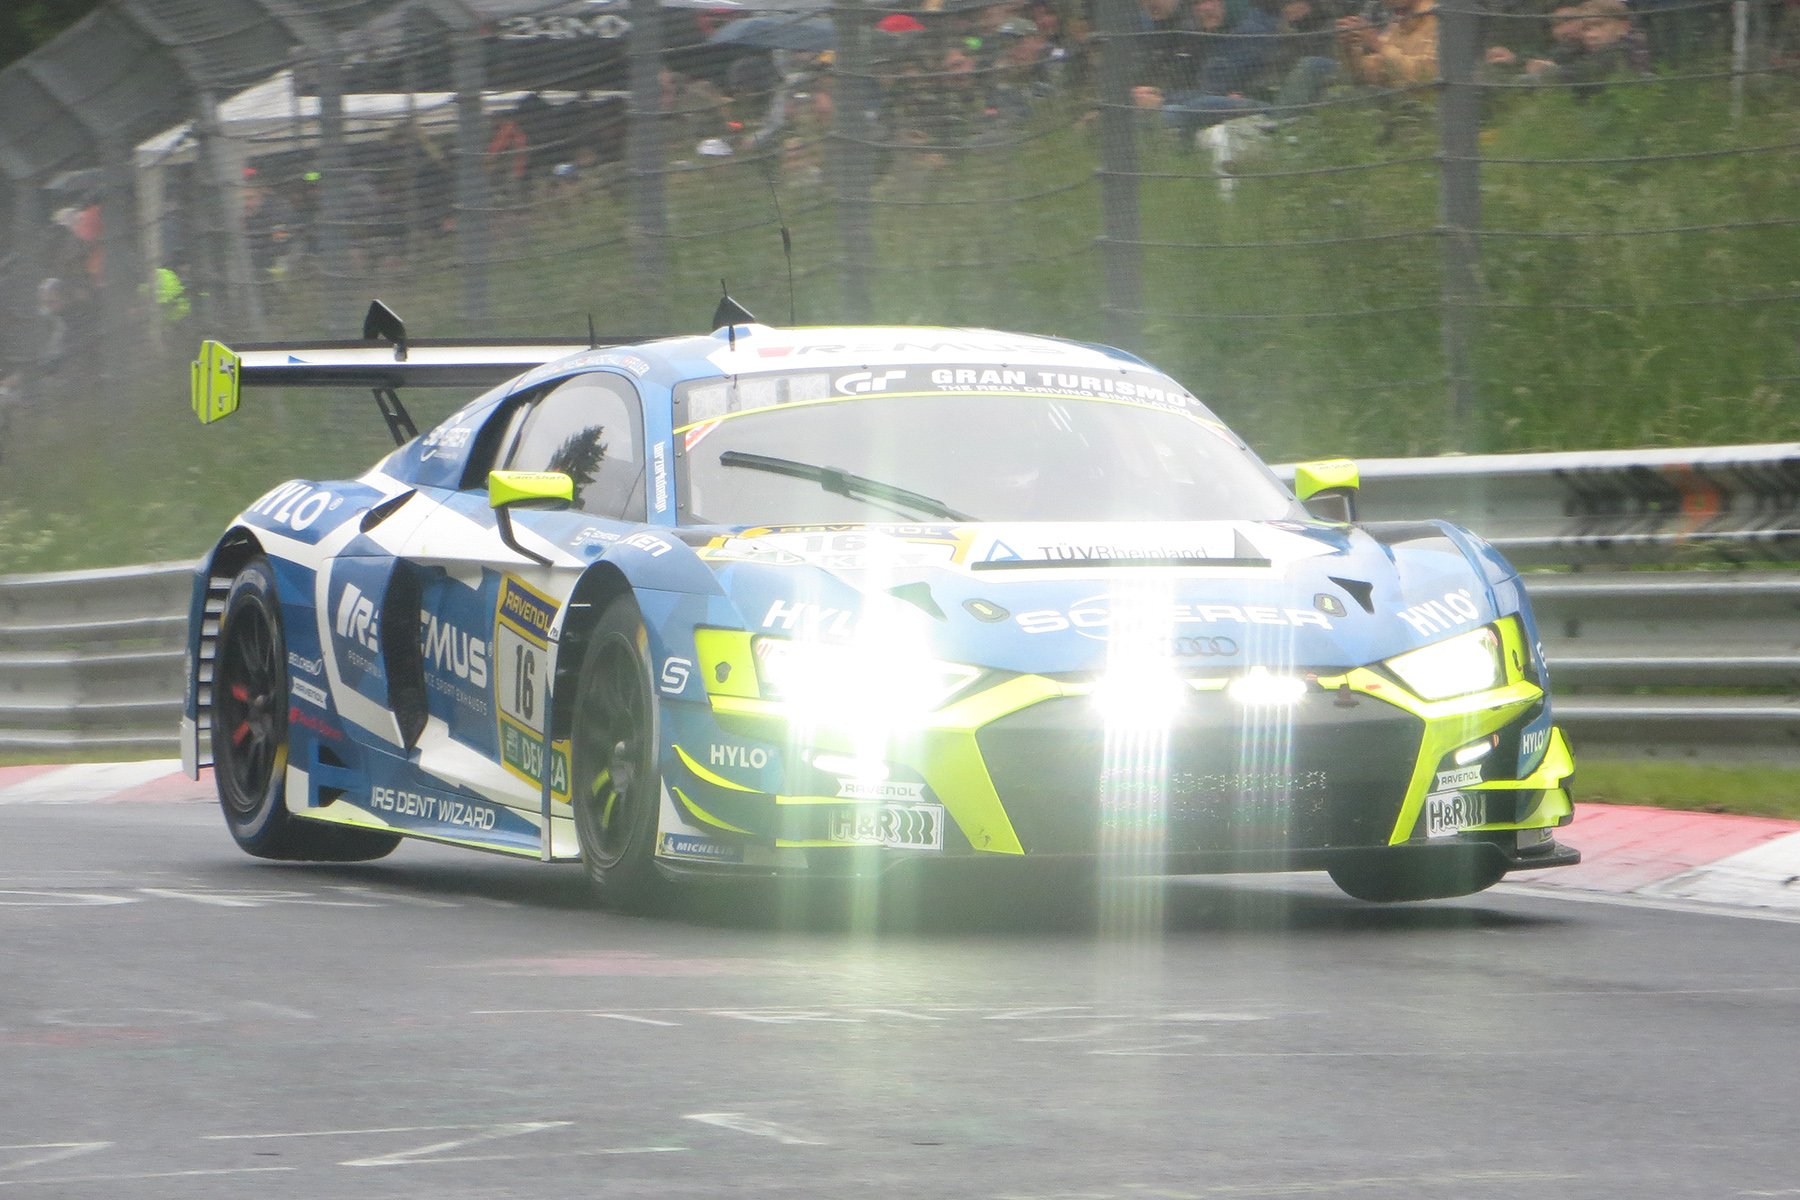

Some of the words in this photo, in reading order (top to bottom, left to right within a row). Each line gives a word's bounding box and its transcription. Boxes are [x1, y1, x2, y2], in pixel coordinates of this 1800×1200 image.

[930, 368, 1026, 387] GRAN
[1037, 371, 1188, 408] TURISMO
[975, 385, 1020, 393] REAL
[1023, 386, 1094, 399] DRIVING
[253, 482, 332, 531] HYLO
[505, 590, 551, 632] RAVENOL
[1396, 592, 1480, 637] HYLO
[514, 644, 535, 721] 16
[710, 744, 767, 769] HYLO
[1523, 731, 1544, 755] HYLO
[844, 784, 916, 798] RAVENOL
[1440, 769, 1480, 786] RAVENOL
[371, 786, 395, 811] IRS
[396, 792, 437, 821] DENT
[438, 801, 496, 831] WIZARD
[833, 807, 899, 841] H&R
[1428, 801, 1468, 831] H&R
